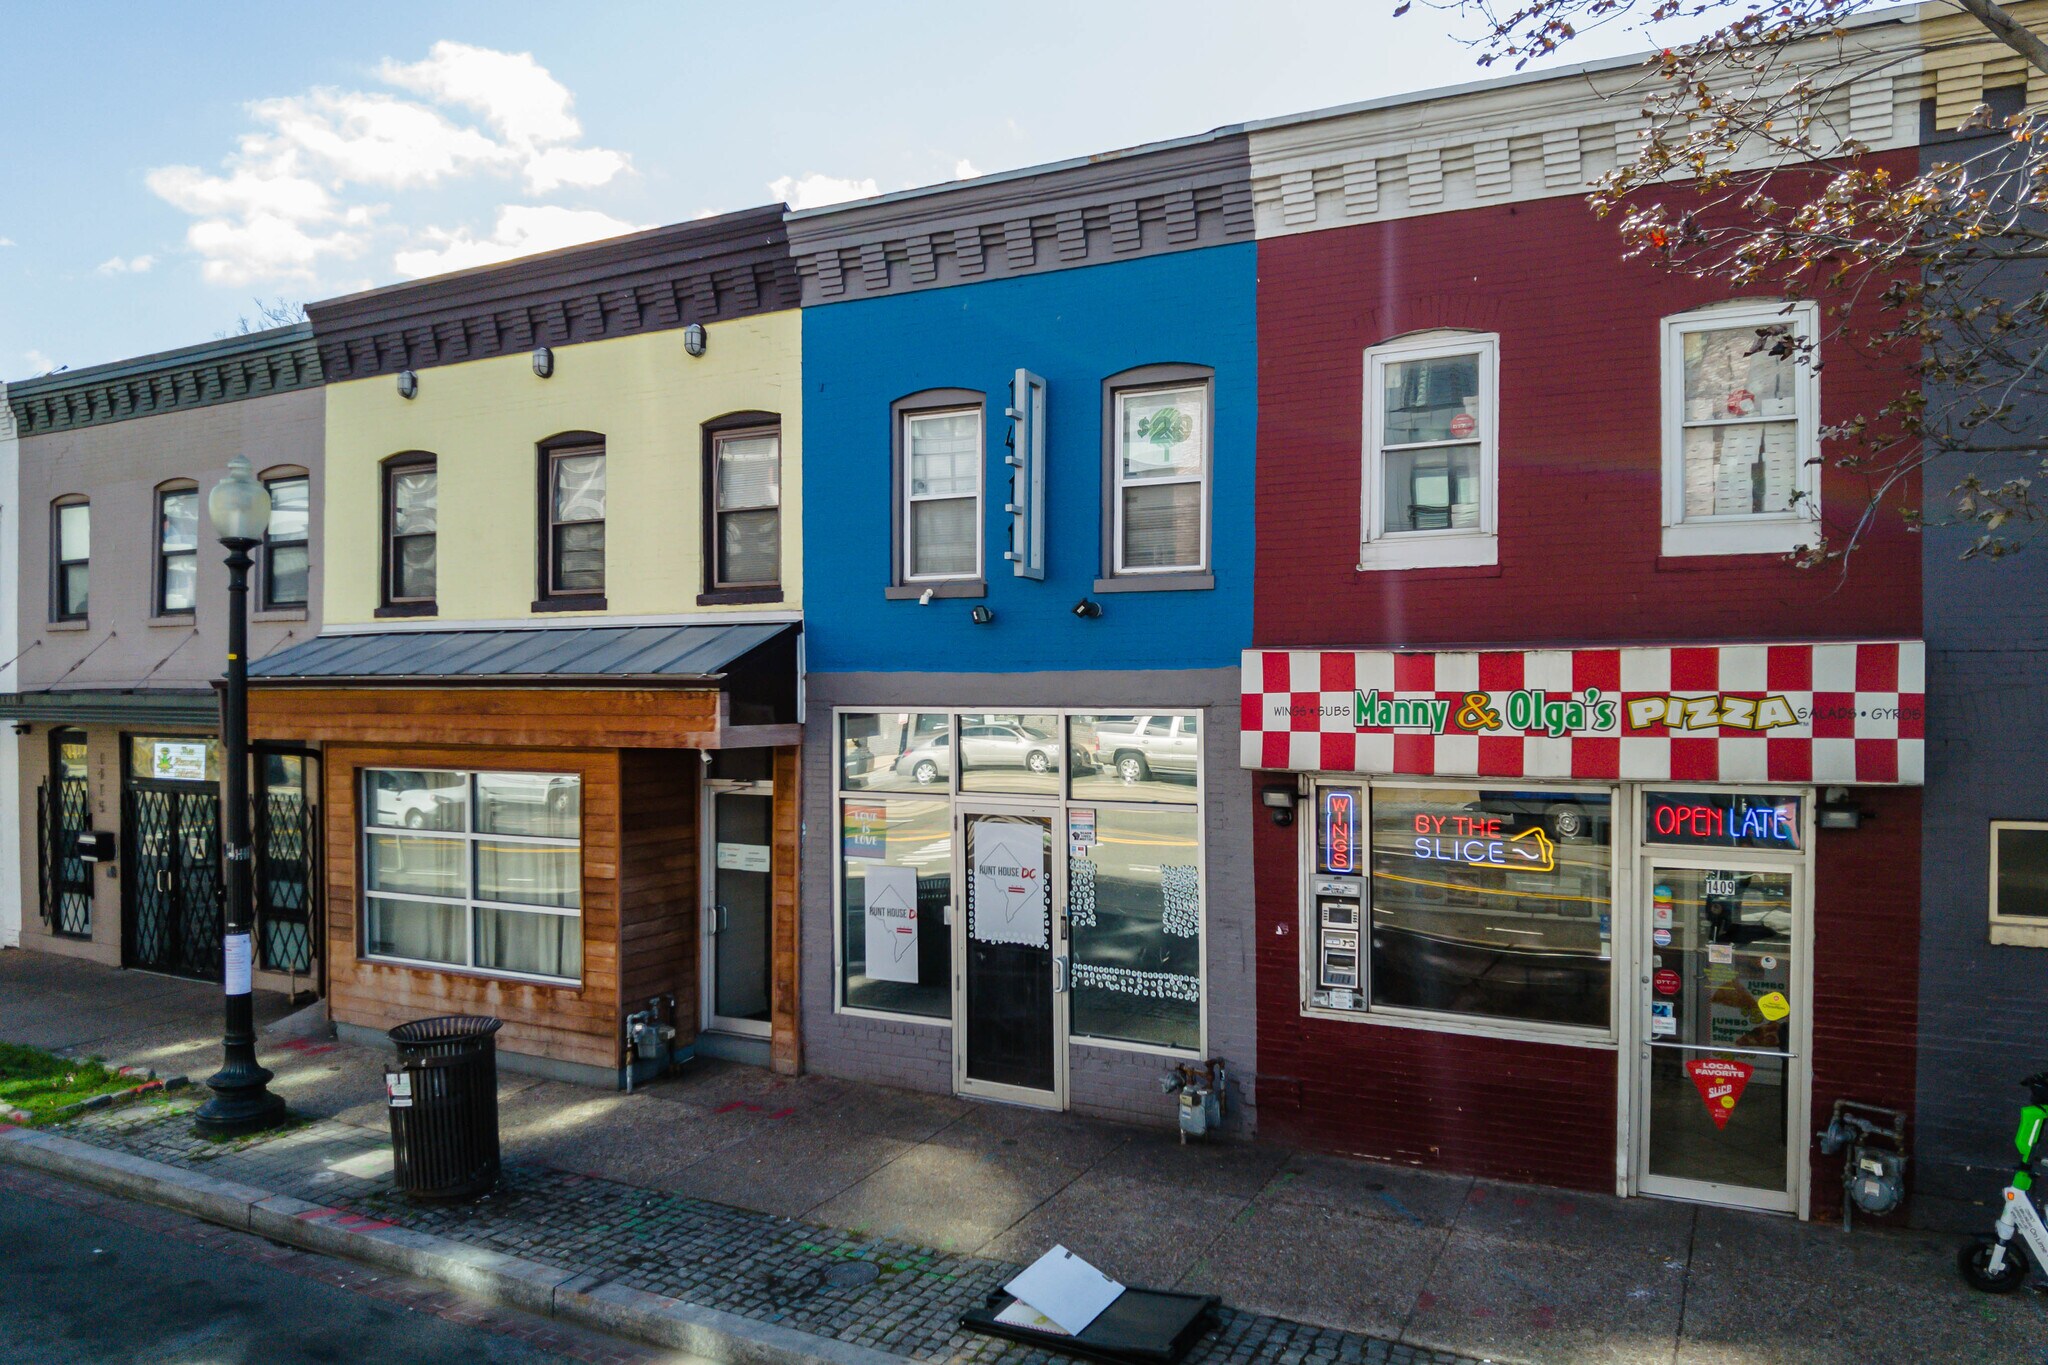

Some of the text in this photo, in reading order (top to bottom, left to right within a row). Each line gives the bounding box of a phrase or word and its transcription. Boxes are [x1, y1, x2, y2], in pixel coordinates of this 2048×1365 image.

[1274, 687, 1922, 738] WINGS SUBS Manny & Olga's PIZZA SALADS GYROS
[1415, 814, 1503, 839] BY THE
[1655, 805, 1788, 840] OPEN LATE
[1331, 797, 1349, 868] WINGS
[854, 835, 878, 846] LOVE
[1414, 837, 1506, 864] SLICE
[998, 866, 1019, 877] HOUSE
[1021, 868, 1036, 879] DC
[1707, 881, 1735, 896] 1409
[887, 908, 907, 918] HOUSE
[1747, 981, 1785, 990] JUMBO
[1712, 1017, 1749, 1026] JUMBO
[1695, 1068, 1745, 1078] FAVORITE
[1703, 1062, 1737, 1071] LOCAL
